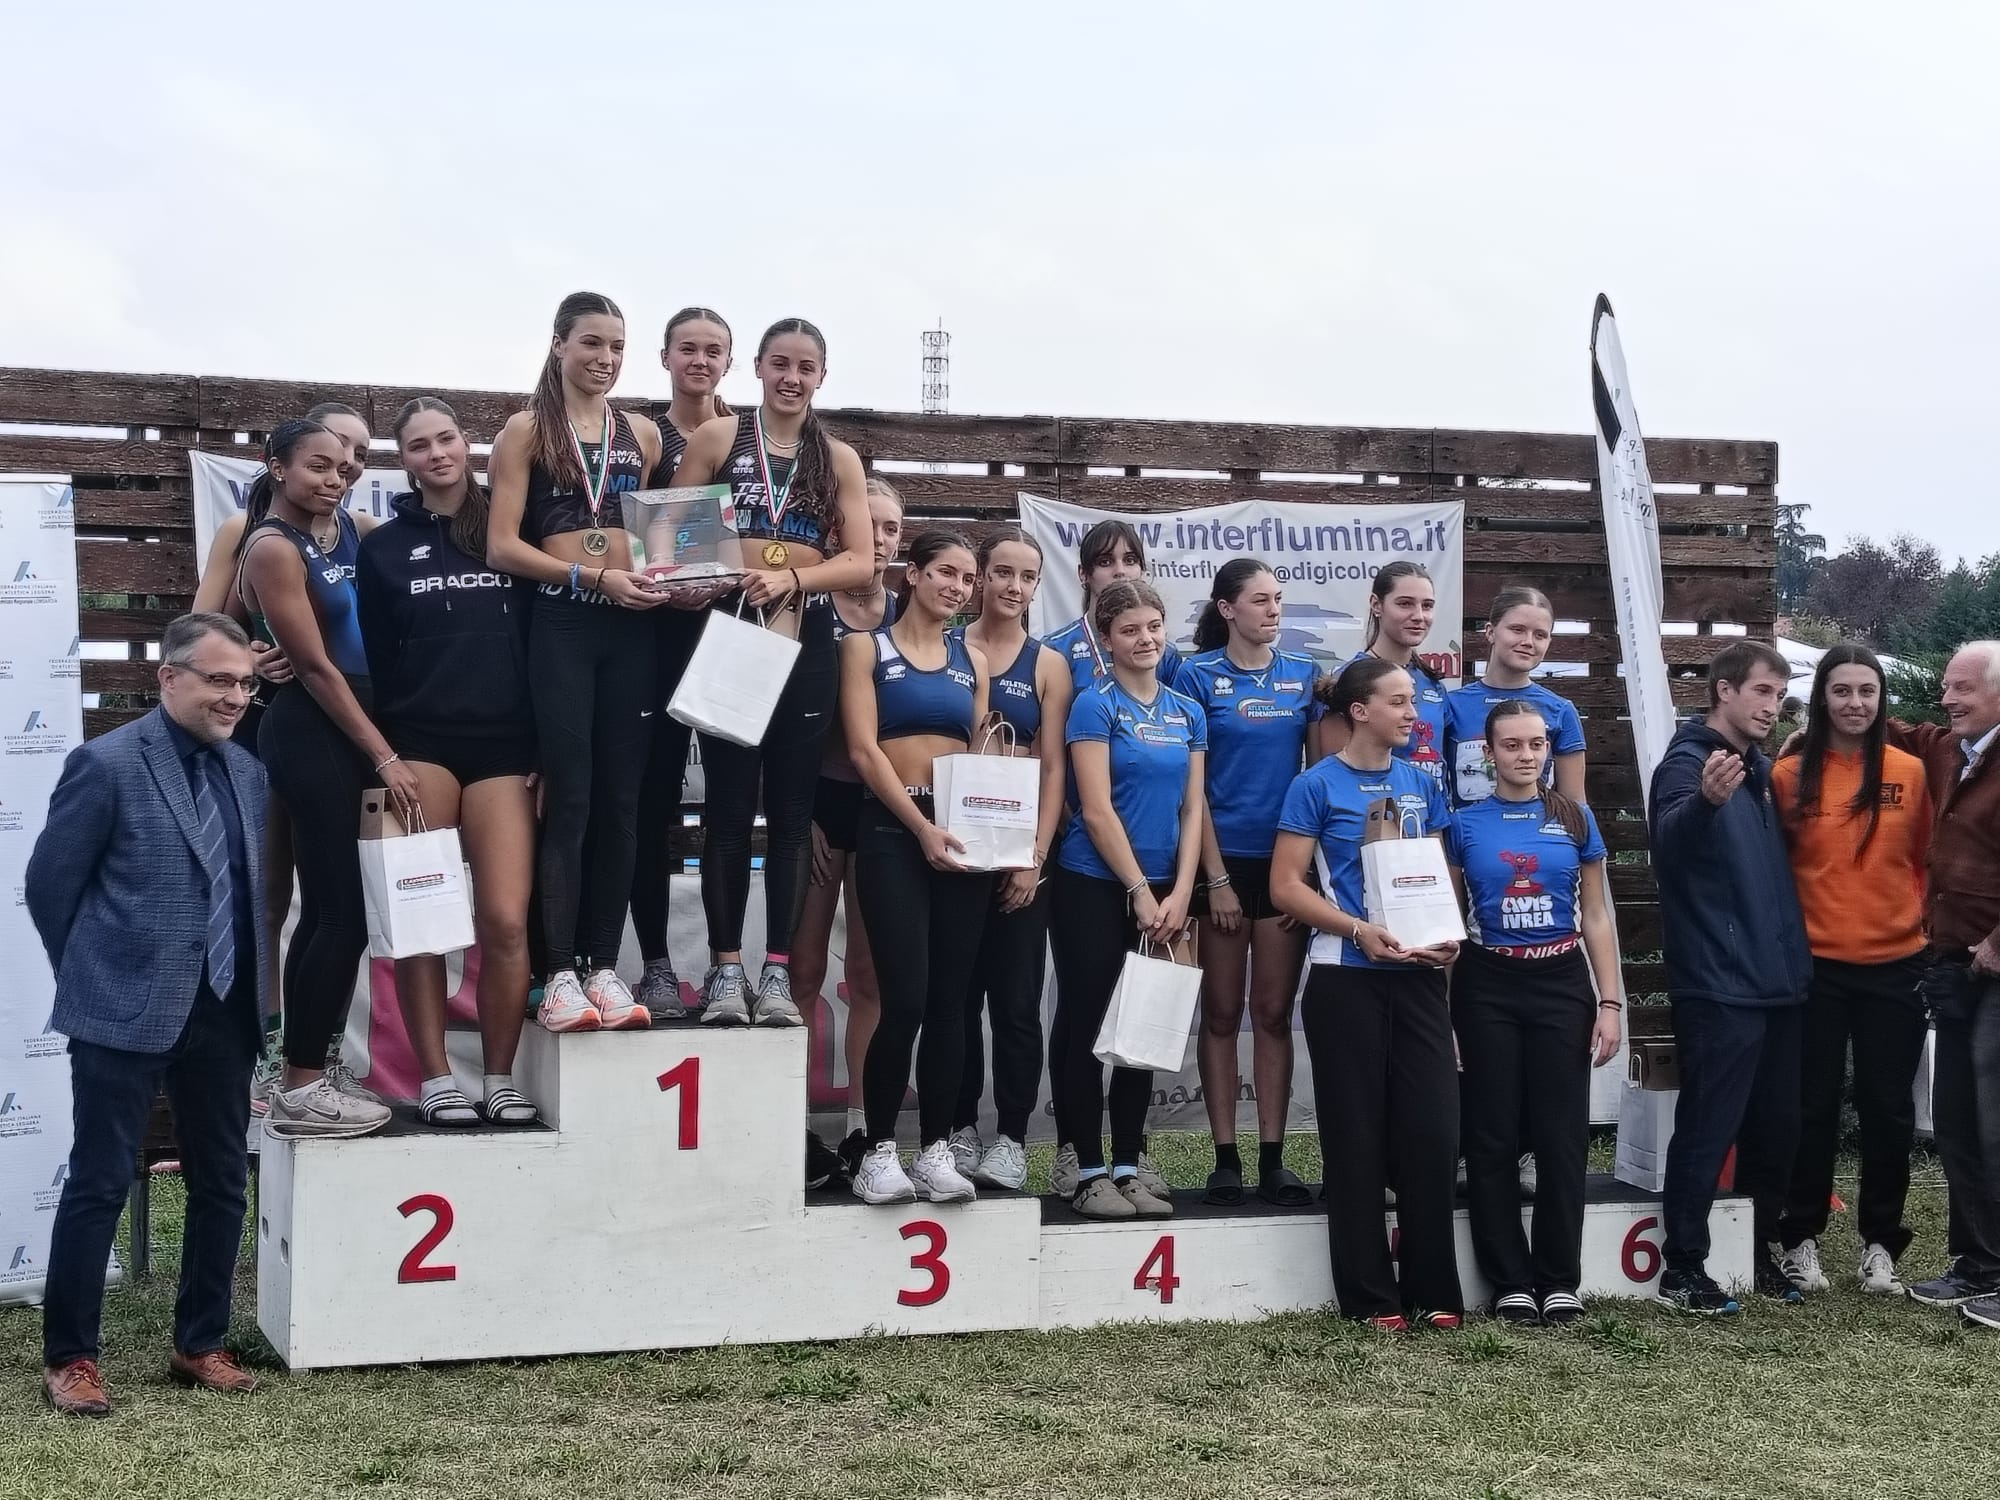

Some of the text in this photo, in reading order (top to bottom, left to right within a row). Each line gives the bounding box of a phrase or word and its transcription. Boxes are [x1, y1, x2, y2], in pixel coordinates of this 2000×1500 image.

[592, 450, 627, 458] TAM
[1055, 517, 1446, 552] ww.interflumina.it
[410, 572, 513, 595] BRACCO
[1000, 679, 1033, 693] ATLETICA
[1502, 895, 1553, 913] AVIS
[1502, 911, 1555, 929] IVREA
[656, 1057, 700, 1151] 1
[397, 1194, 456, 1284] 2
[1621, 1217, 1661, 1283] 6
[897, 1221, 951, 1306] 3
[1133, 1236, 1180, 1304] 4
